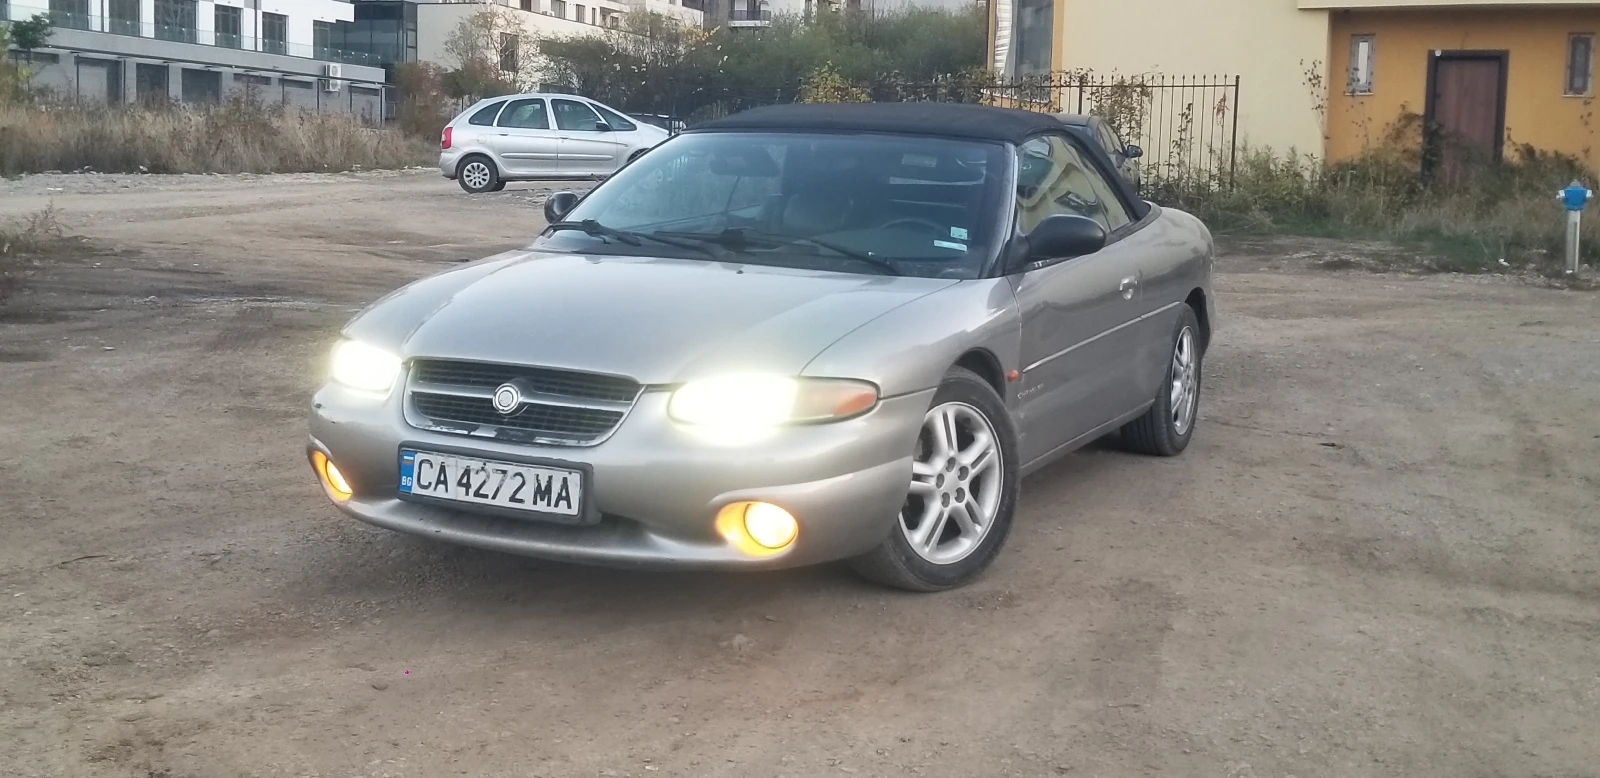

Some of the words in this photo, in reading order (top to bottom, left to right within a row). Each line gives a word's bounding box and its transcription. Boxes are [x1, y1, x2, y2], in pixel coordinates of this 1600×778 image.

[401, 476, 412, 487] BG
[416, 459, 449, 493] CA
[456, 465, 526, 504] 4272
[532, 474, 573, 510] MA
